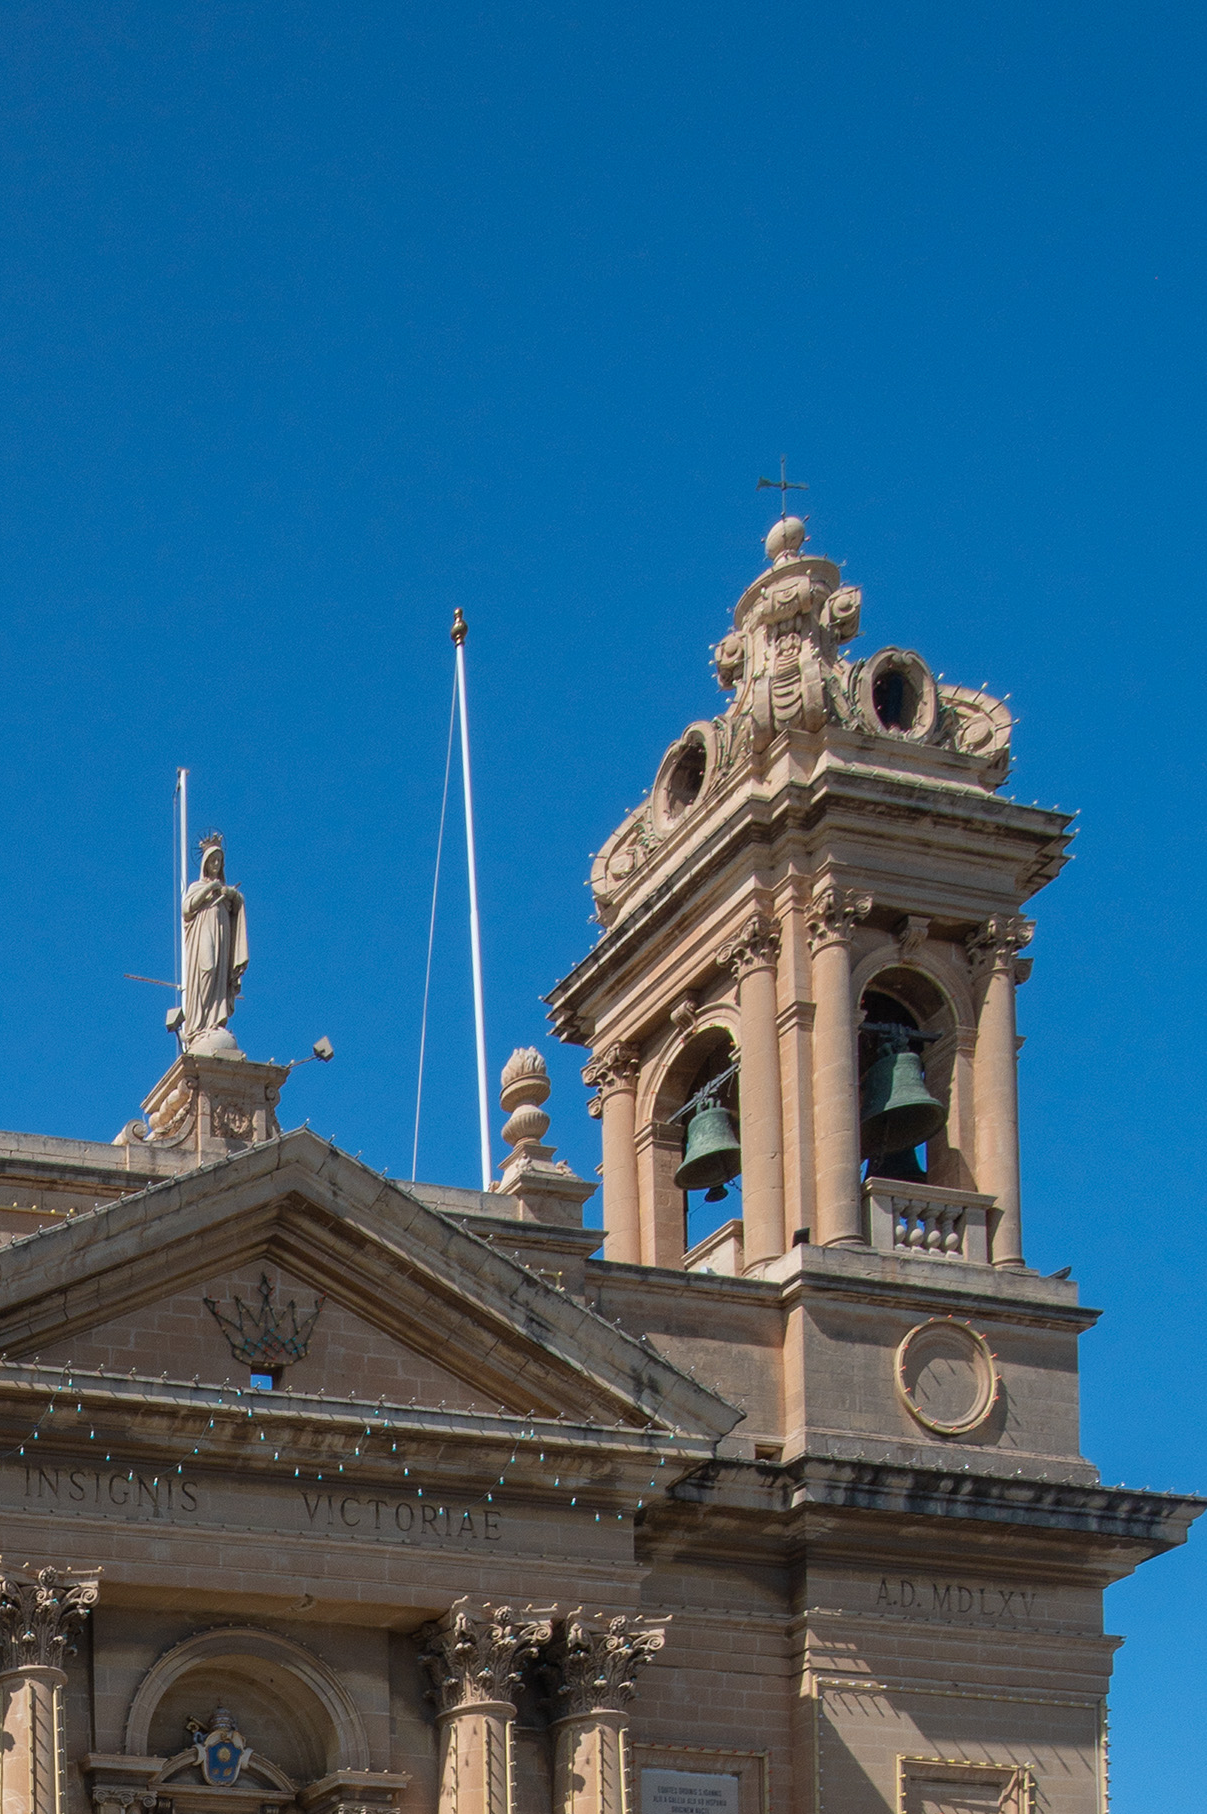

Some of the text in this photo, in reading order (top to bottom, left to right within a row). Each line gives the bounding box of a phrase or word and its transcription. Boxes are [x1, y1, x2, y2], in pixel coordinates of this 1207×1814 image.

[22, 1466, 505, 1542] INSIGNIS VICTORIAE
[875, 1578, 1037, 1618] A.D. MDLXV
